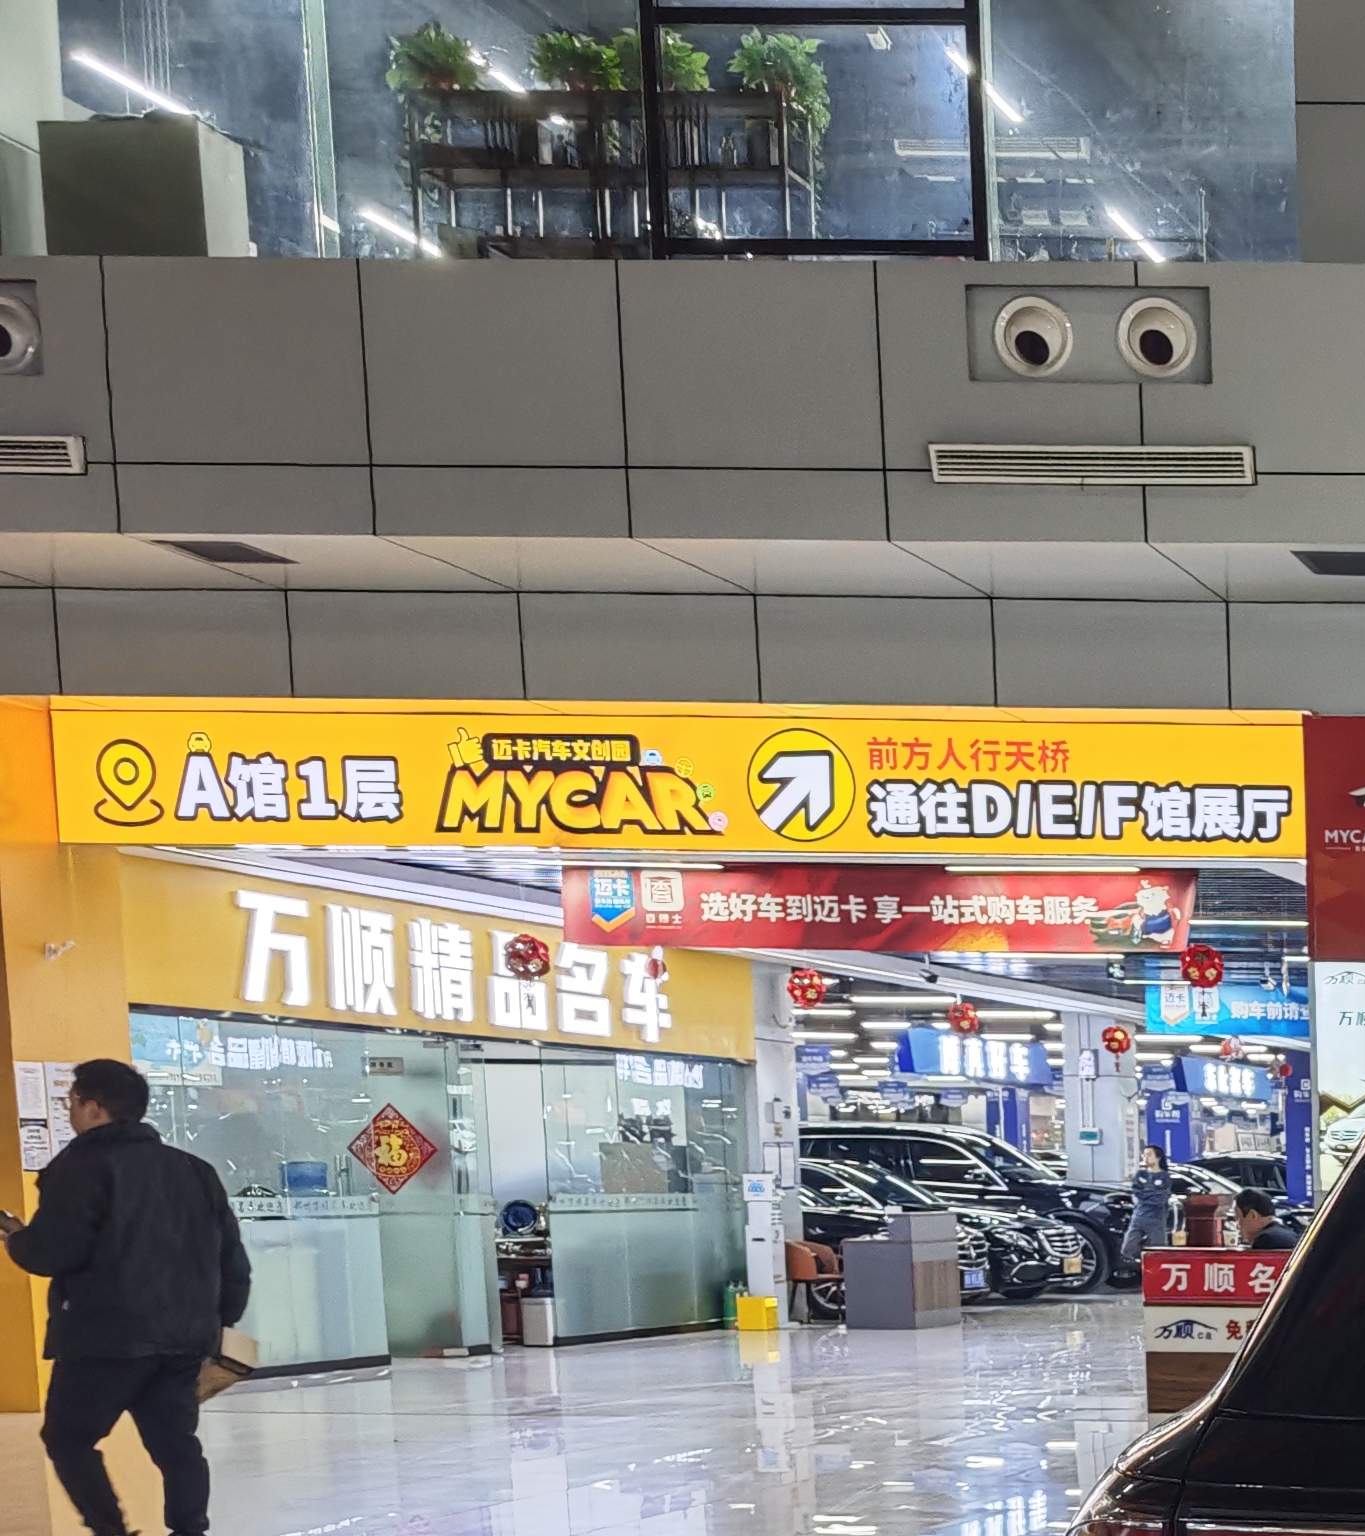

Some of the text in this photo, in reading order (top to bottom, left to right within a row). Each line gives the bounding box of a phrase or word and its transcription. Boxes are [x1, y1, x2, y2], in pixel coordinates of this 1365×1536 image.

[492, 739, 630, 761] 迈卡汽车文创园
[867, 737, 1070, 774] 前方人行天桥
[174, 752, 403, 823] A馆1层
[438, 767, 722, 836] MYCAR
[866, 779, 1292, 842] 通往D/E/F馆展厅
[701, 893, 1099, 926] 选好车到迈卡 享一站式购车服务
[234, 889, 673, 1043] 万顺精品名车
[1160, 1262, 1277, 1294] 万顺名
[1226, 1319, 1255, 1341] 免
